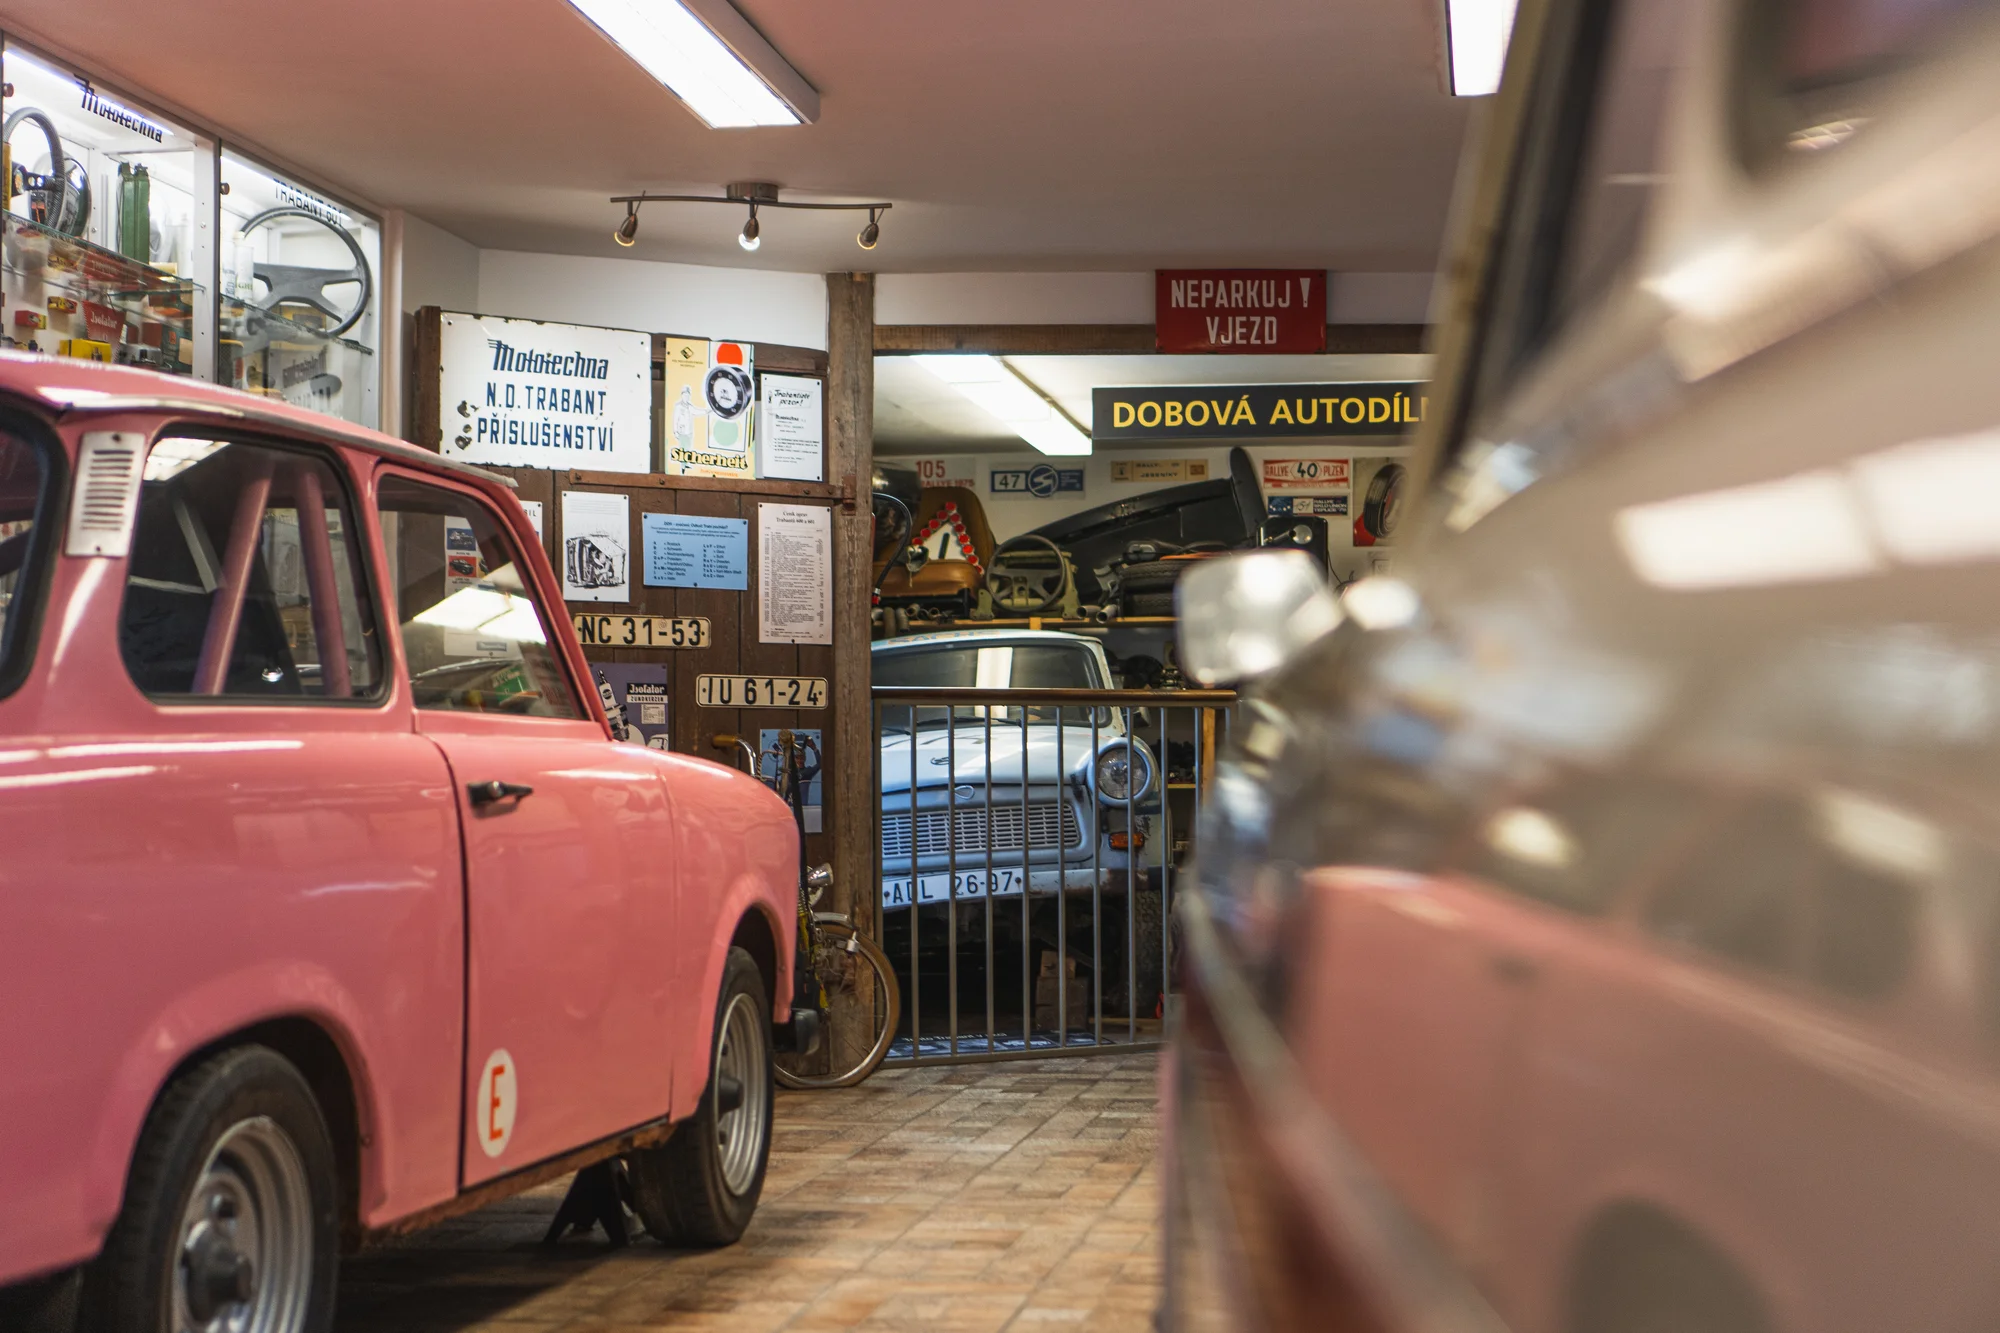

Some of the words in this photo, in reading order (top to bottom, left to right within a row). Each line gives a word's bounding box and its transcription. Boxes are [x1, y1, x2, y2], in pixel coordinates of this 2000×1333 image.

[1171, 279, 1291, 308] NEPARKUJ
[1206, 316, 1278, 345] VJEZD
[487, 338, 609, 380] Mototechna
[1113, 394, 1257, 428] DOBOVÁ
[1269, 391, 1430, 424] AUTODÍL
[477, 412, 614, 452] PŘÍSLUŠENSTVÍ
[671, 447, 748, 470] Sicherheit
[916, 460, 945, 478] 105
[1265, 465, 1289, 476] RALLYE
[1297, 462, 1318, 478] 40
[999, 474, 1020, 489] 47
[582, 616, 612, 644] NC
[623, 617, 701, 646] 31-53
[744, 678, 818, 706] 61-24
[489, 1064, 506, 1141] E
